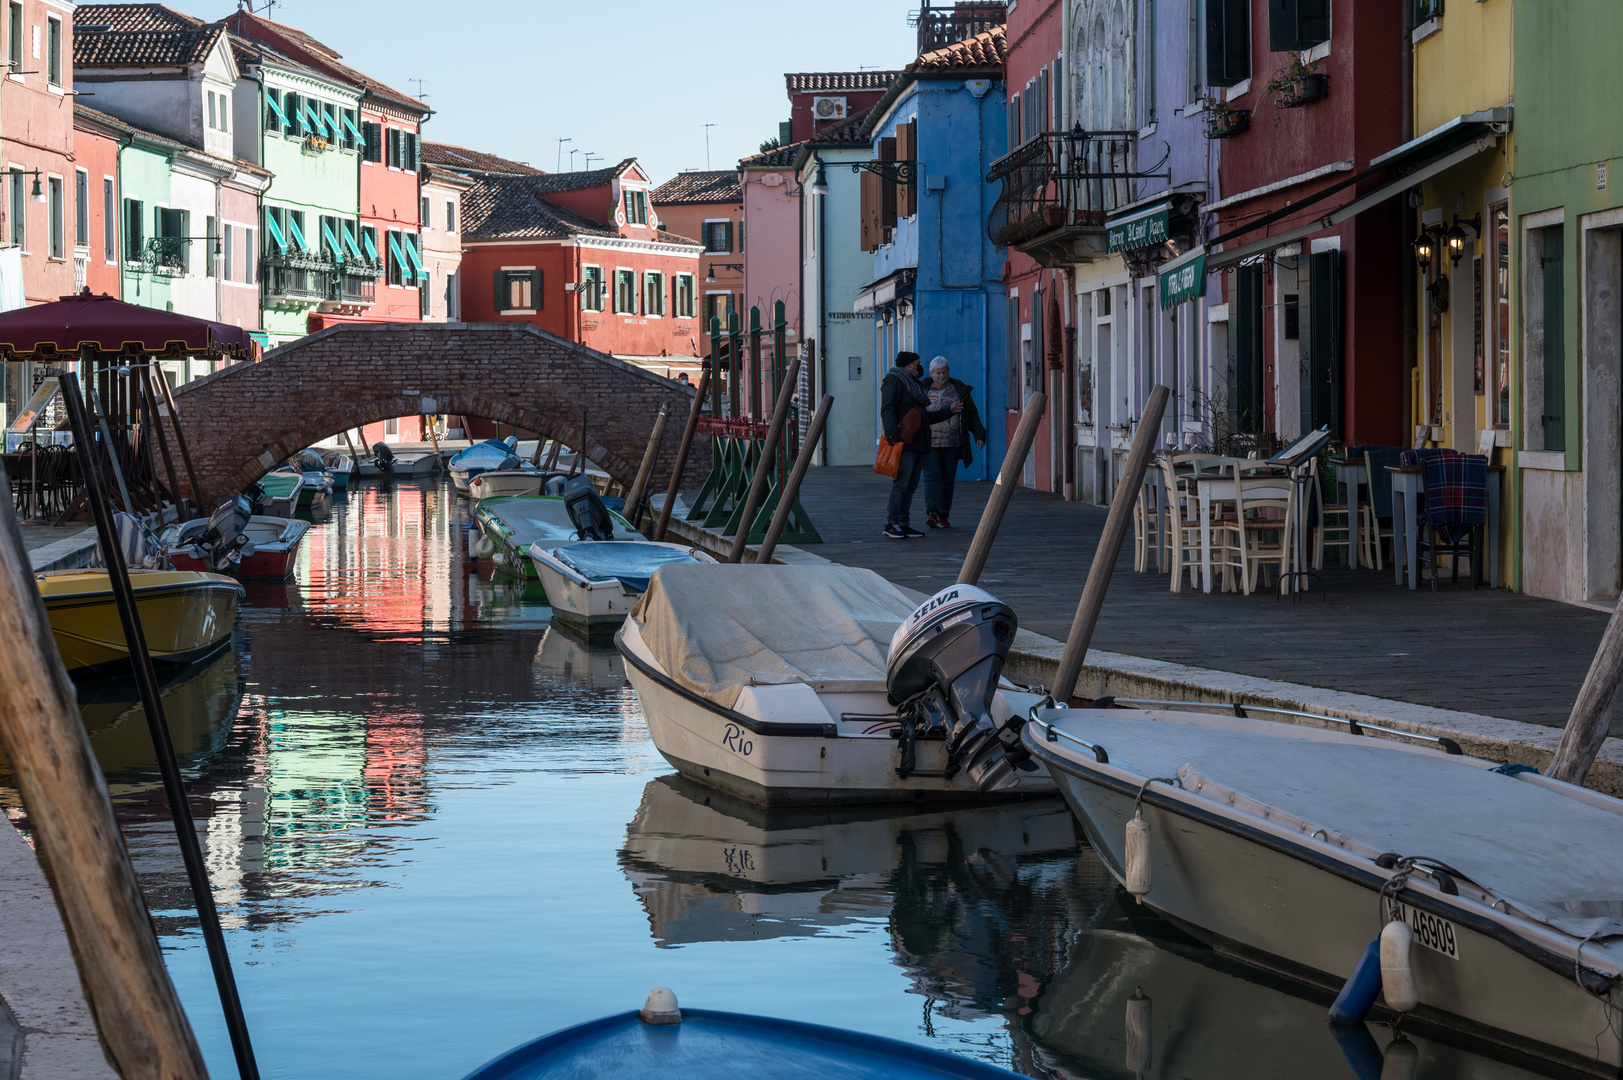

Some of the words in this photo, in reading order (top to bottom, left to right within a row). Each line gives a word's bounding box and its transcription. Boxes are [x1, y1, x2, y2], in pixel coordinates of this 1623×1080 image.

[912, 590, 959, 624] SELVA
[722, 722, 754, 757] Rio
[1413, 909, 1455, 956] 46909
